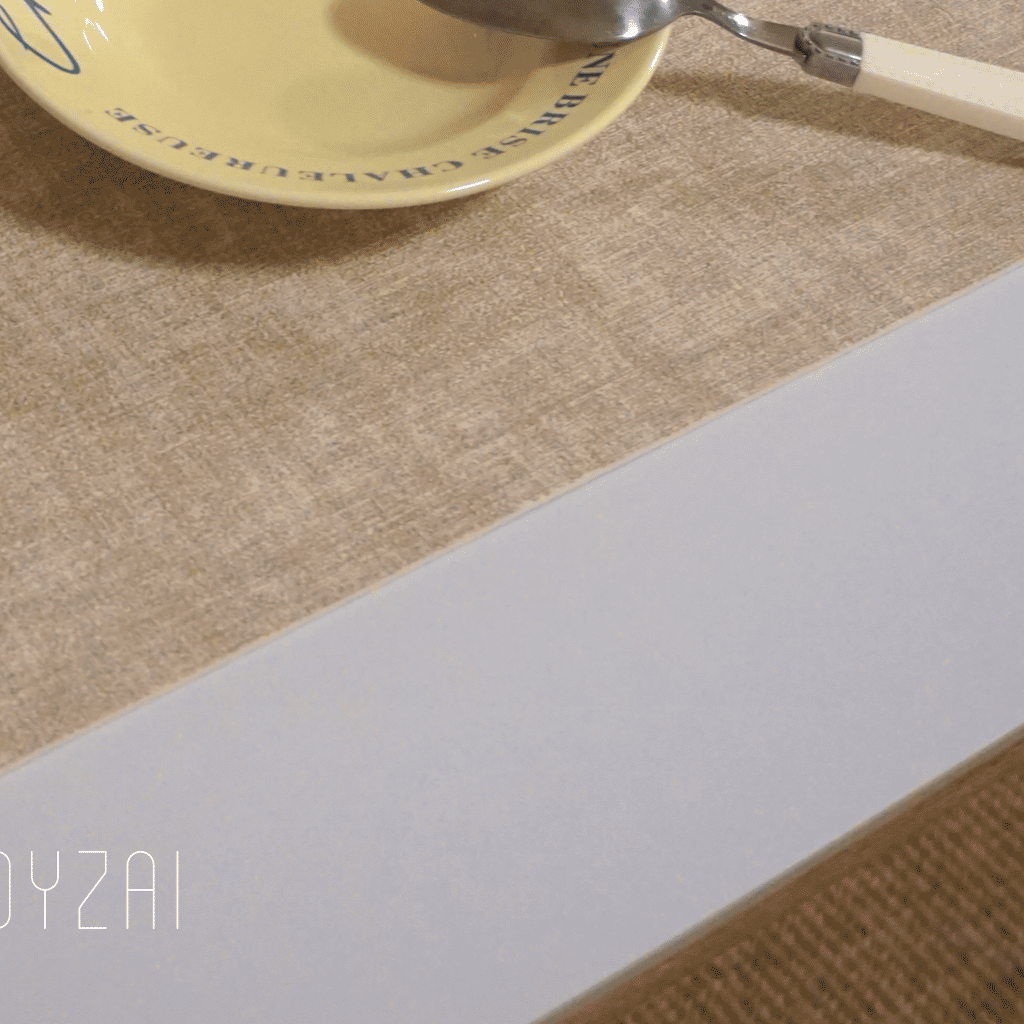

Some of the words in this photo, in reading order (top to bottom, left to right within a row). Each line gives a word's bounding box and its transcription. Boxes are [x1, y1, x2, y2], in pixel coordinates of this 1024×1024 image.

[568, 51, 616, 87] NE
[104, 105, 464, 183] CHALEUREUSE
[470, 92, 590, 160] BRISE
